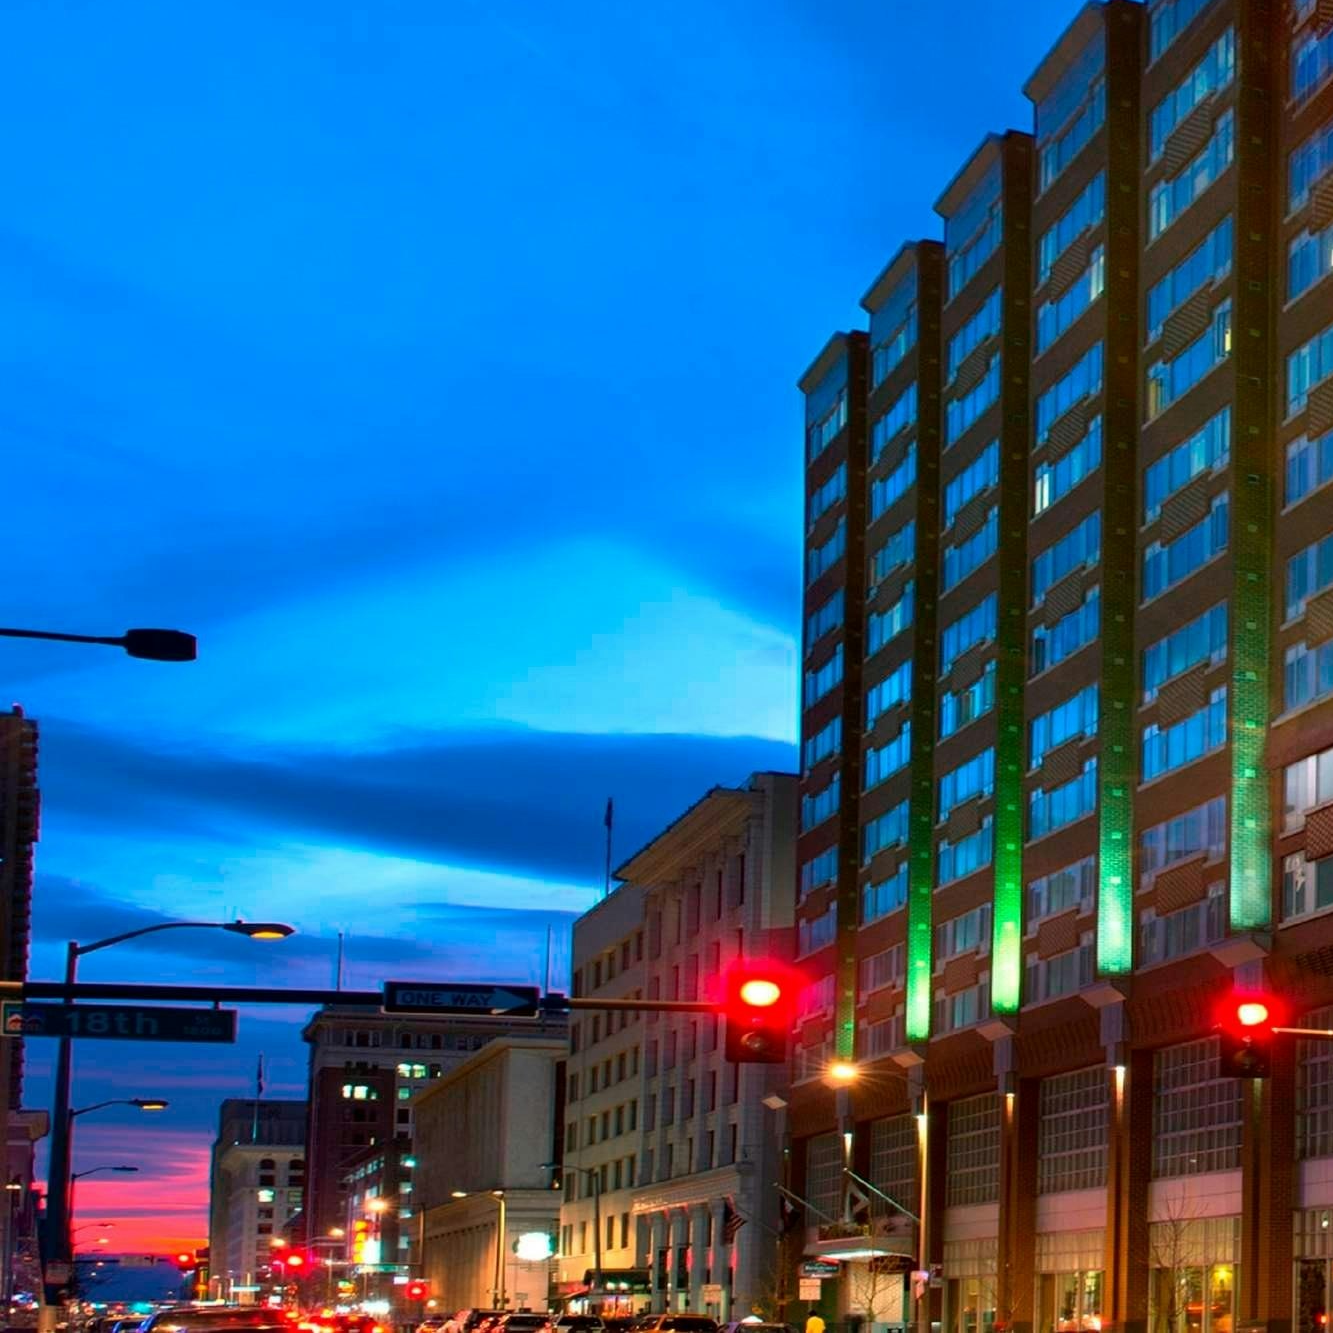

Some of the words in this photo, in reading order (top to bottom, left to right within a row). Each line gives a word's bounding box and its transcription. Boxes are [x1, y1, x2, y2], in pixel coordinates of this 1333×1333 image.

[401, 991, 443, 1006] ONE
[451, 993, 493, 1007] WAY
[65, 1011, 158, 1035] 18th
